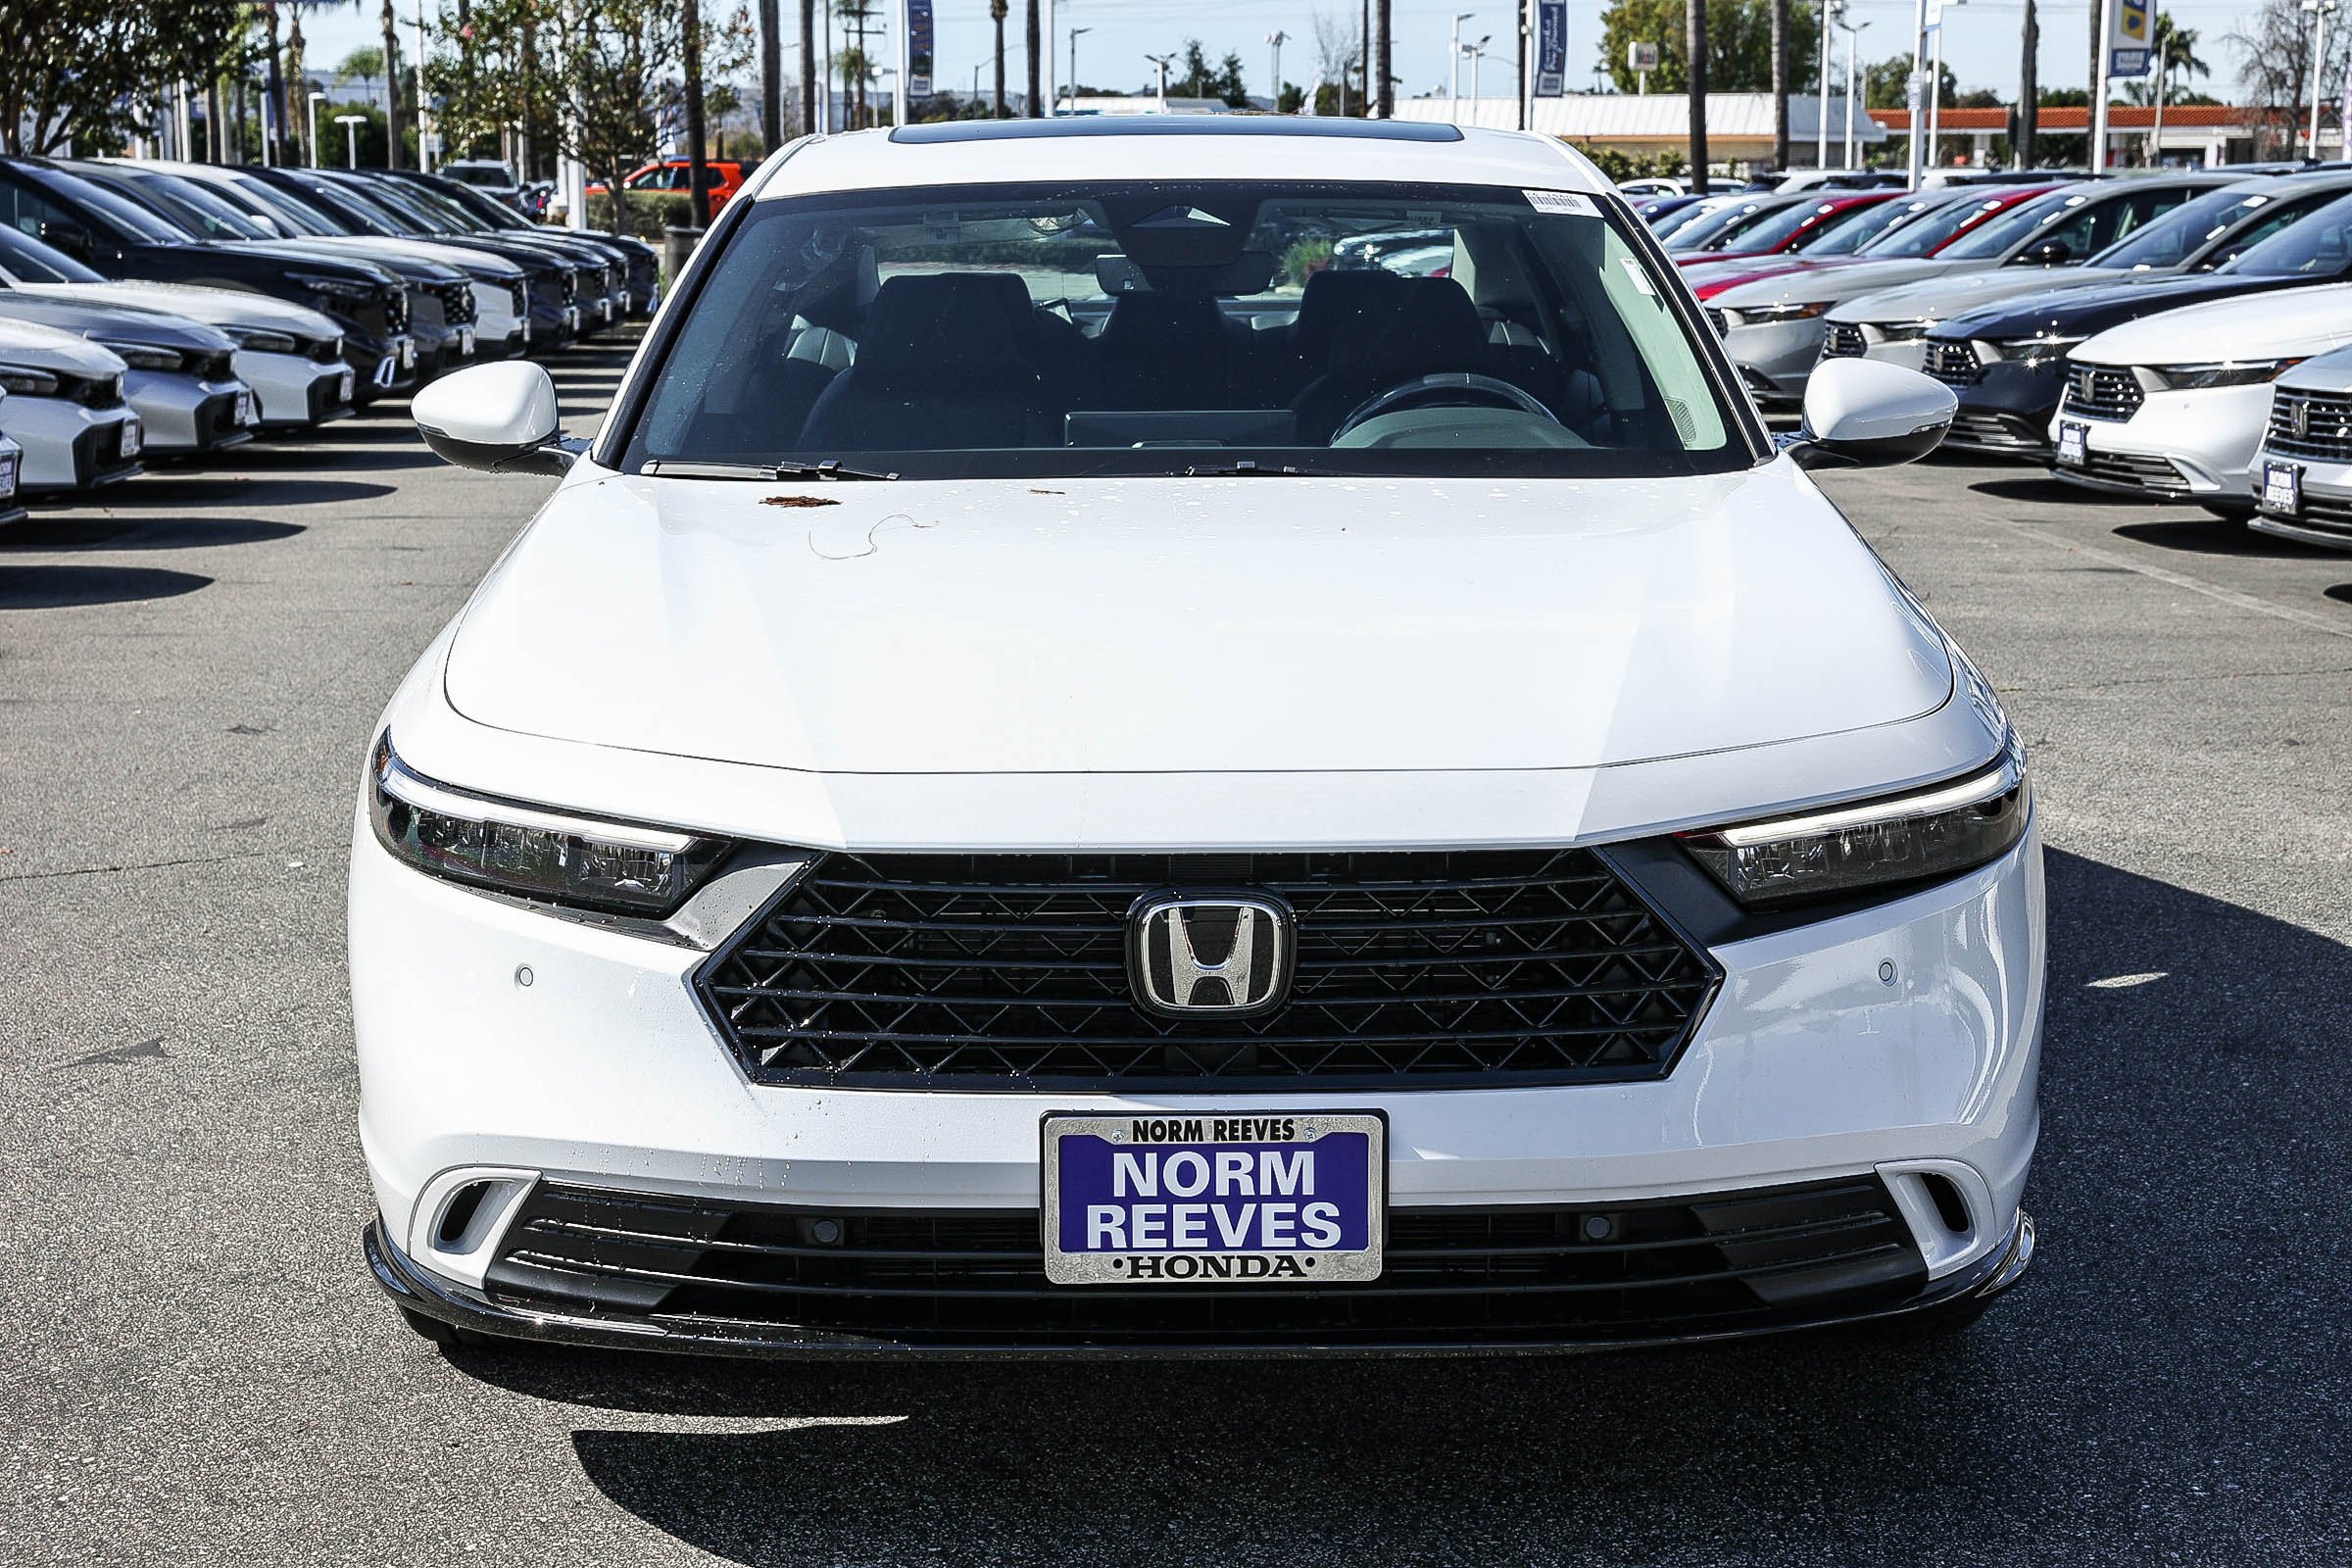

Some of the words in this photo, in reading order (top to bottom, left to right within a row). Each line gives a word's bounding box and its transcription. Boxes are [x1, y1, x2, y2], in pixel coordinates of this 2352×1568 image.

[1132, 1119, 1203, 1143] NORM
[1213, 1118, 1295, 1142] REEVES
[1113, 1151, 1315, 1198] NORM
[1087, 1201, 1342, 1250] REEVES
[1126, 1254, 1307, 1279] HONDA
